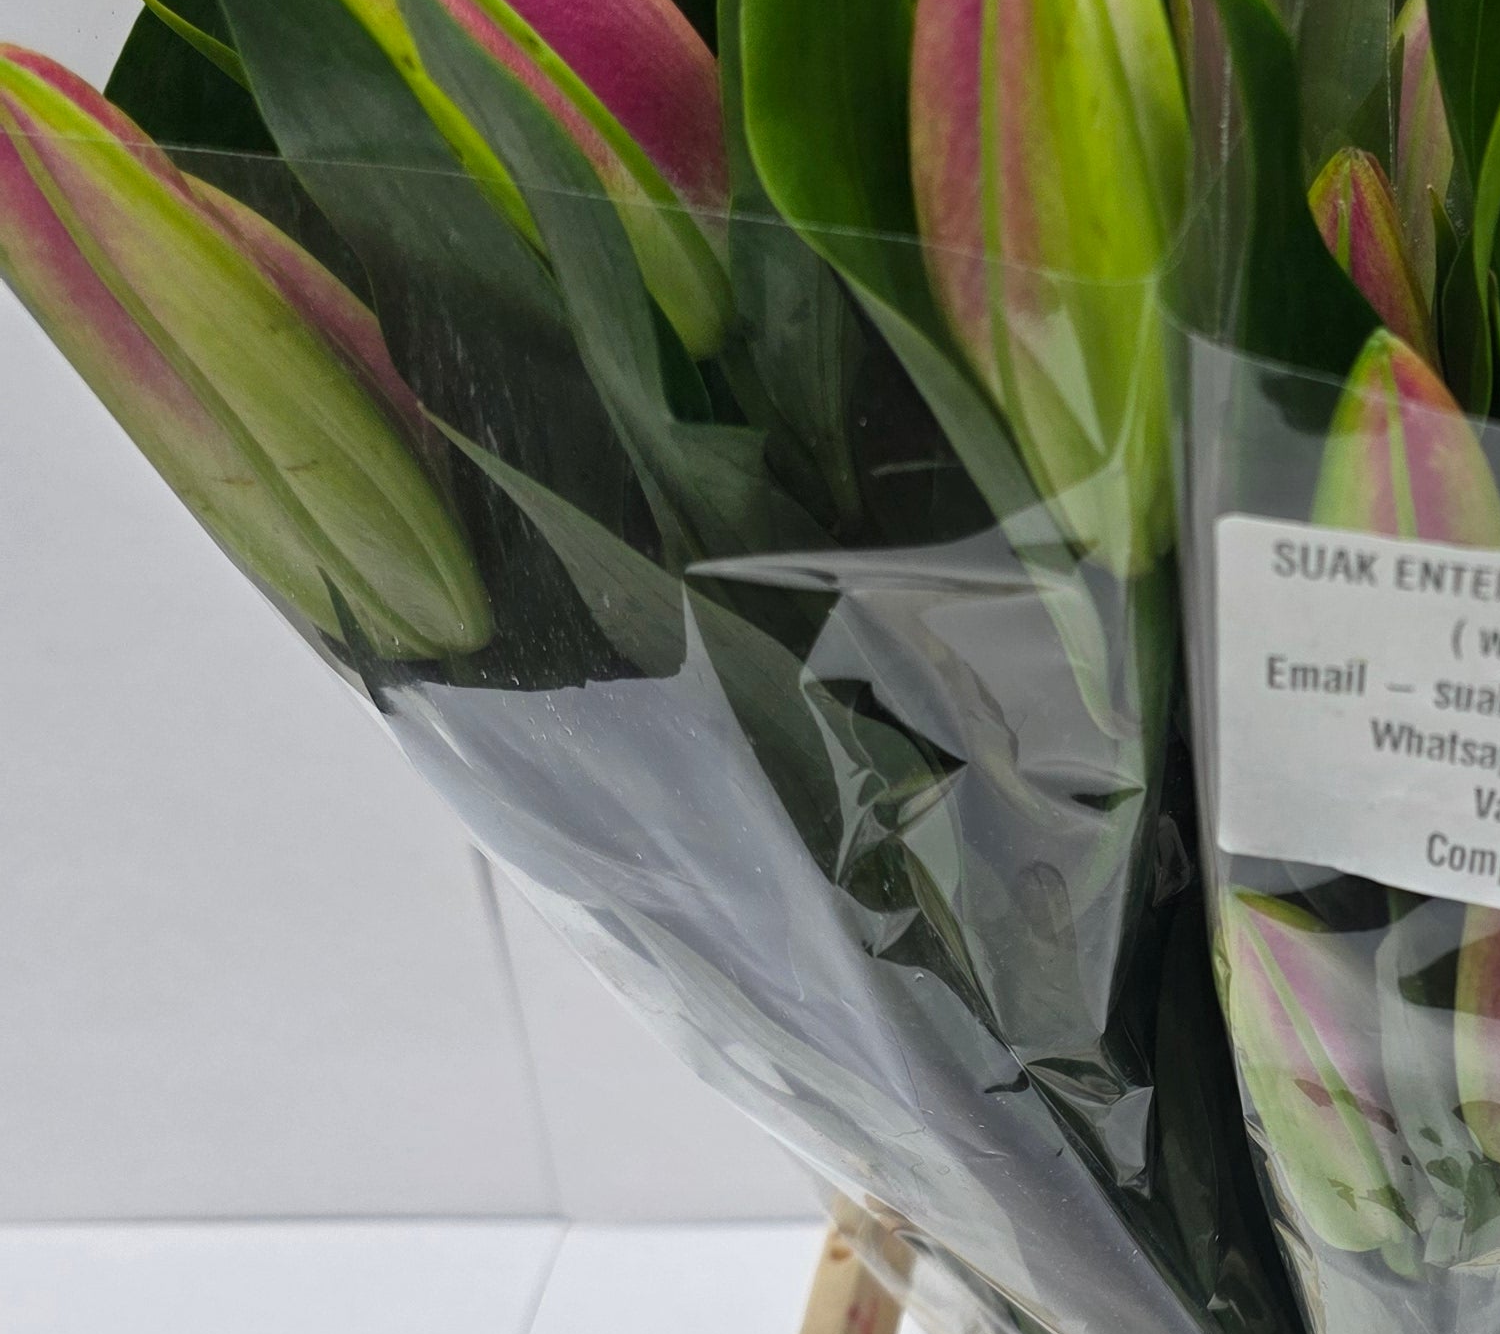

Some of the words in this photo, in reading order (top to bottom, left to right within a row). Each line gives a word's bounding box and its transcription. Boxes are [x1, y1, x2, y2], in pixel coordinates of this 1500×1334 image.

[1271, 538, 1379, 586] SUAK
[1450, 616, 1468, 661] (
[1265, 654, 1367, 697] Email
